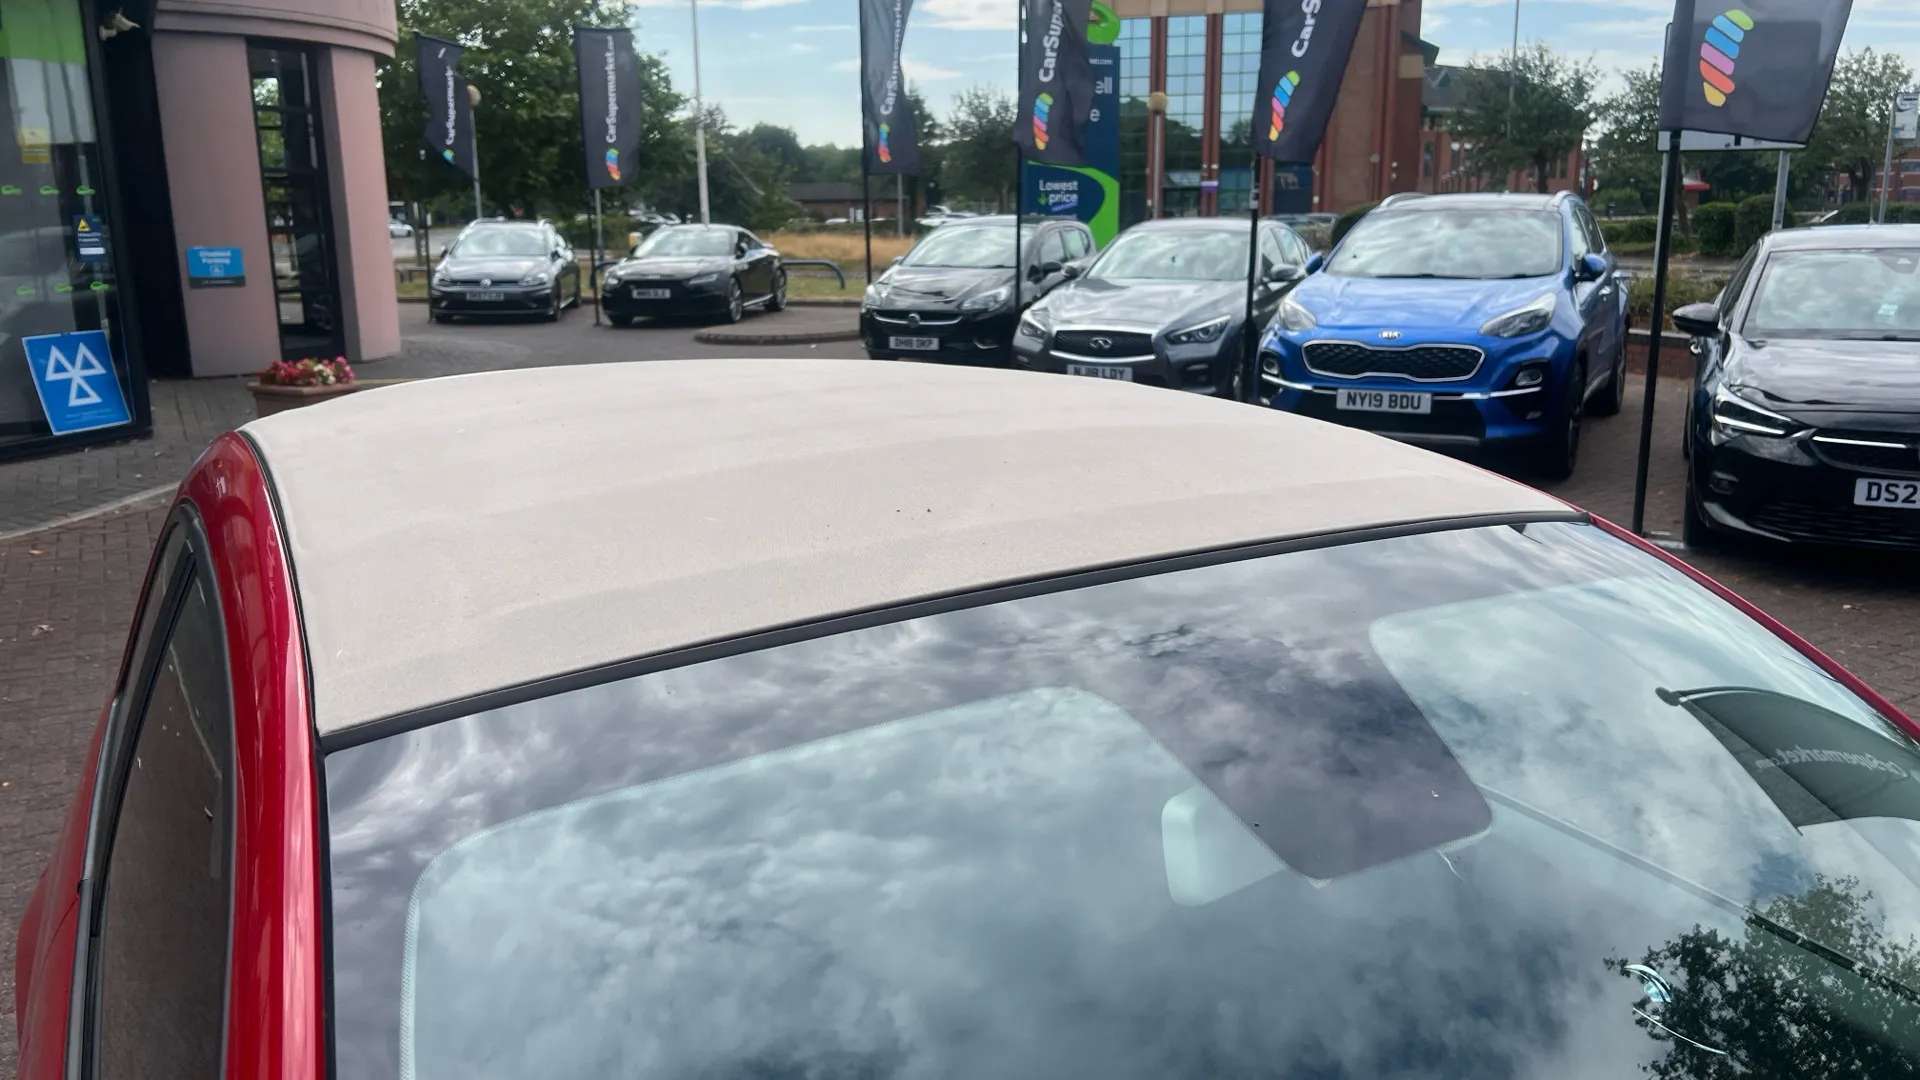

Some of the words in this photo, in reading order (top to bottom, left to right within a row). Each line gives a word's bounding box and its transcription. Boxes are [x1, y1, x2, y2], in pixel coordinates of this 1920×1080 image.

[1291, 0, 1321, 57] CarS
[1039, 180, 1078, 191] Lowest
[1048, 192, 1079, 206] price
[1346, 391, 1384, 408] NY19
[1388, 394, 1422, 410] BDU
[1865, 481, 1918, 504] DS2
